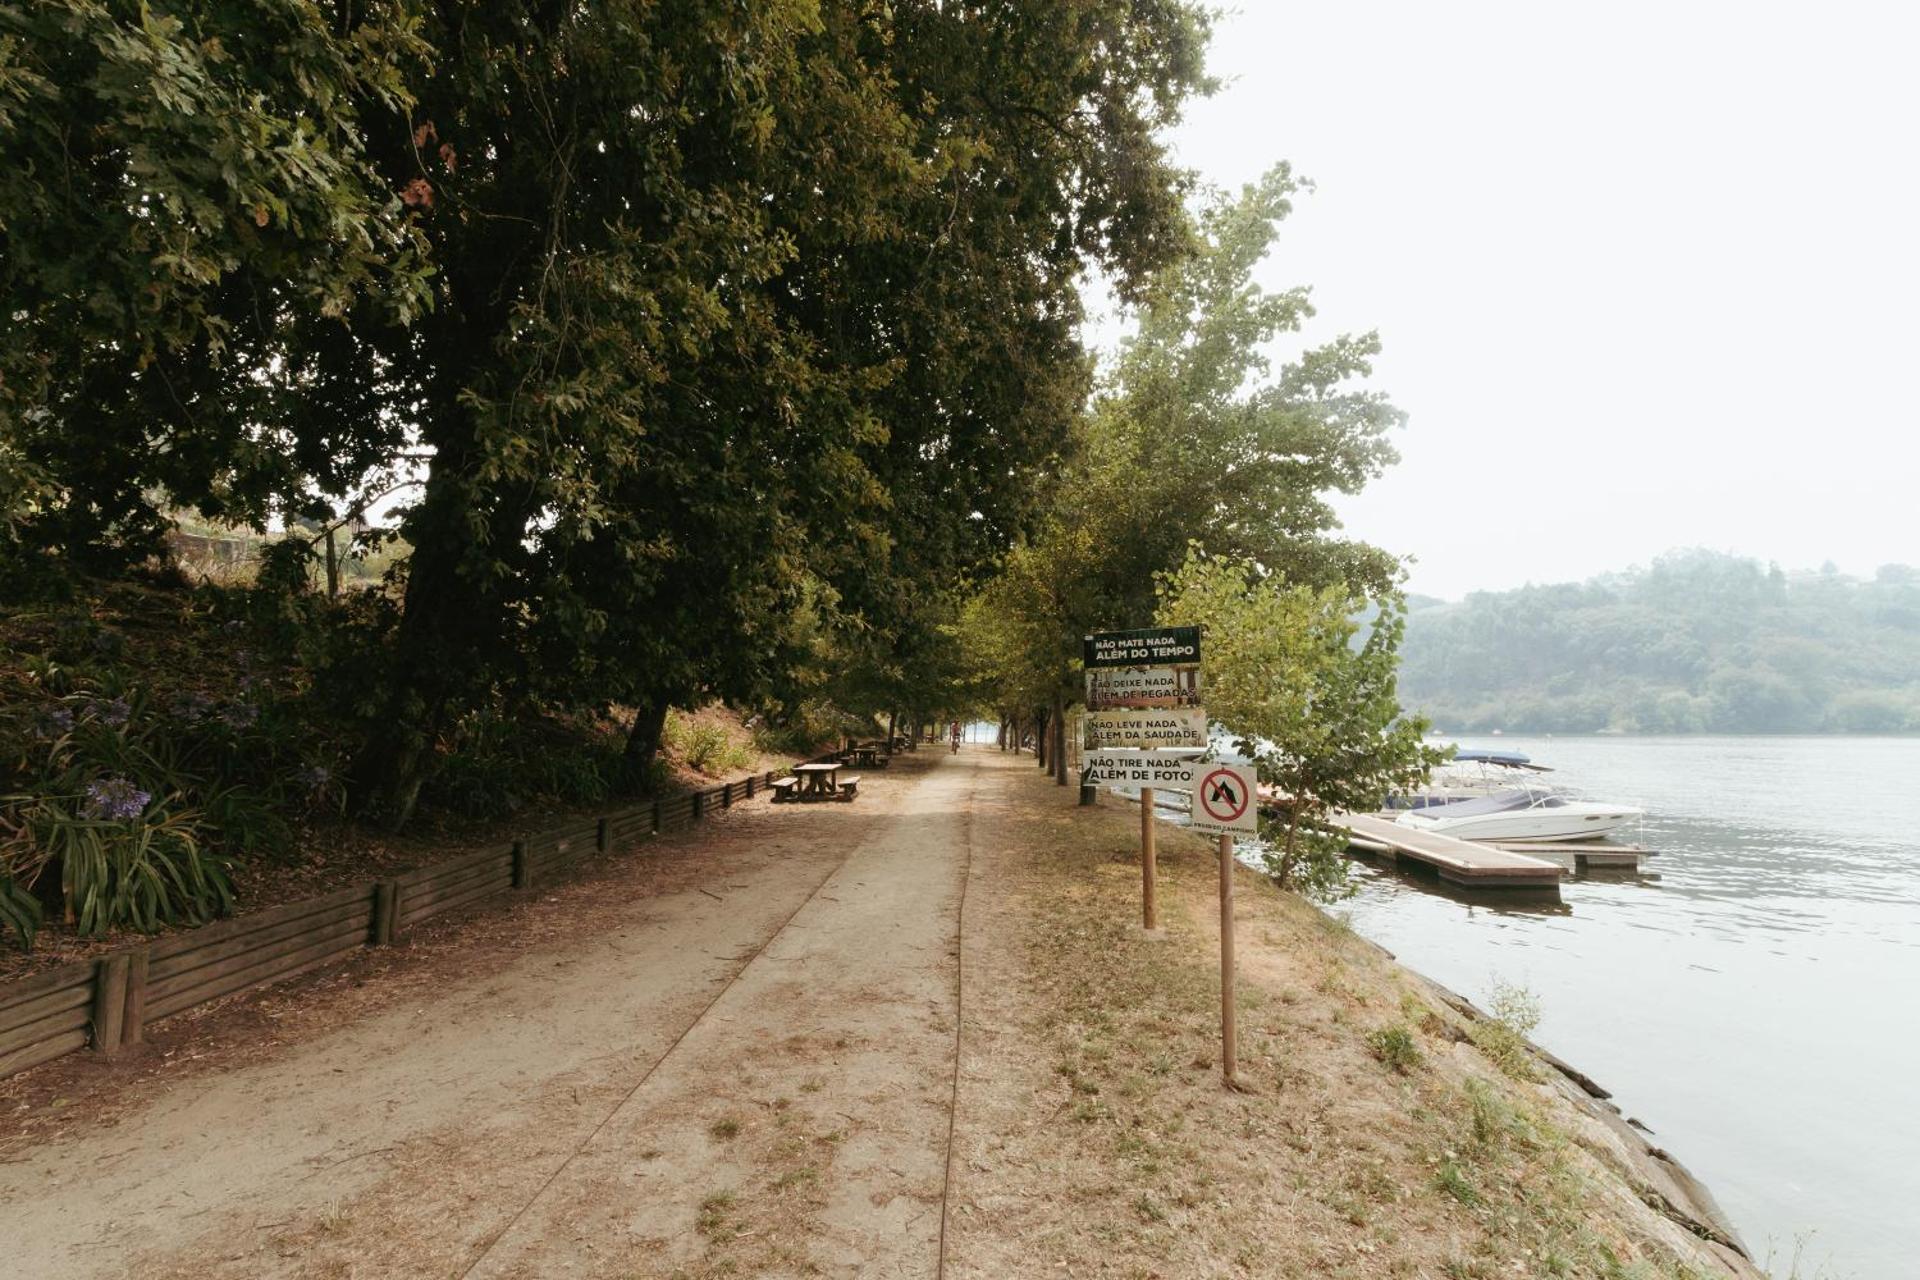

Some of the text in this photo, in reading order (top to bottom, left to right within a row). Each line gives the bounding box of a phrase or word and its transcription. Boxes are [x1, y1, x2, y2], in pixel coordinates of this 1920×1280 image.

[1096, 636, 1175, 649] NÃO MATE NADA
[1096, 646, 1193, 660] ALÉM DO TEMPO
[1113, 679, 1141, 688] DEIXE
[1145, 678, 1175, 686] NADA
[1122, 690, 1137, 699] DE
[1141, 687, 1196, 699] PEGADAS
[1091, 719, 1177, 729] NÃO LEVE NADA
[1125, 731, 1140, 739] DA
[1144, 730, 1198, 739] SAUDADE
[1090, 756, 1181, 768] NÃO TIRE NADA
[1090, 767, 1194, 781] ALÉM DE FOTO
